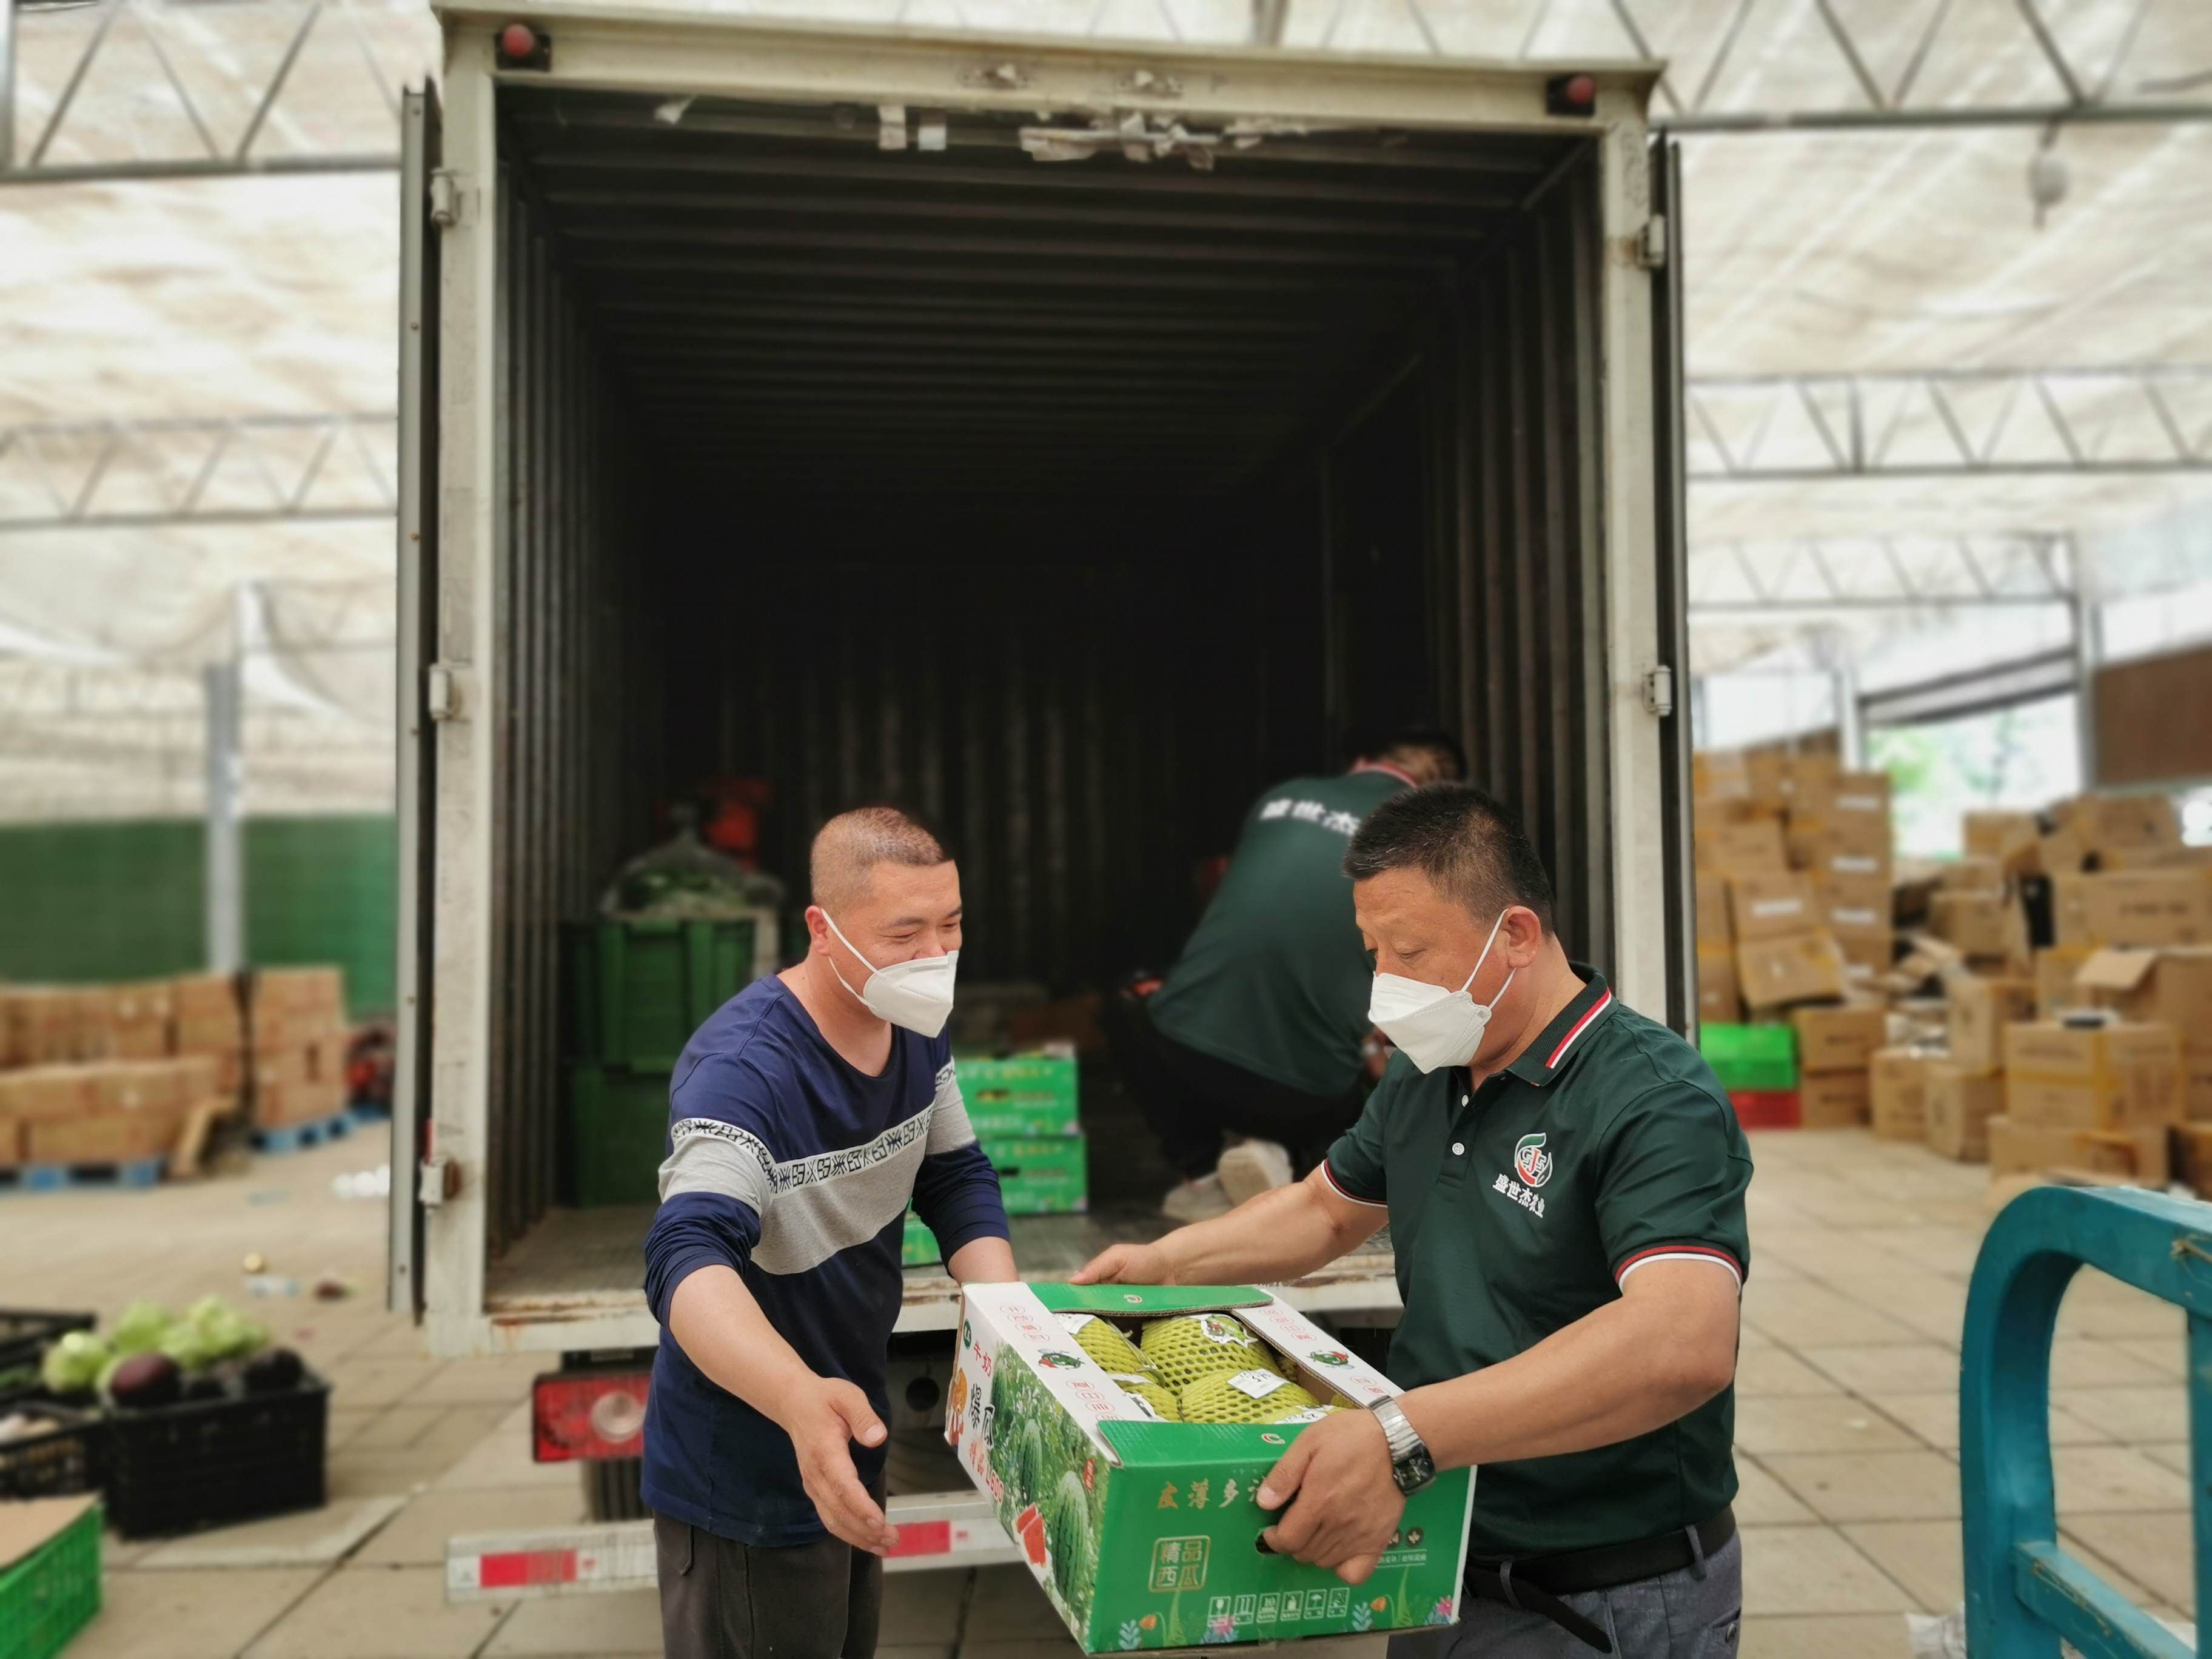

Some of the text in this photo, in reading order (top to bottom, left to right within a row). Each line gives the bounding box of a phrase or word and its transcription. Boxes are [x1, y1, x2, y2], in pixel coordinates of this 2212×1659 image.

[973, 1341, 992, 1378] 牛奶
[1159, 1540, 1203, 1564] 精品
[1156, 1564, 1199, 1587] 西瓜
